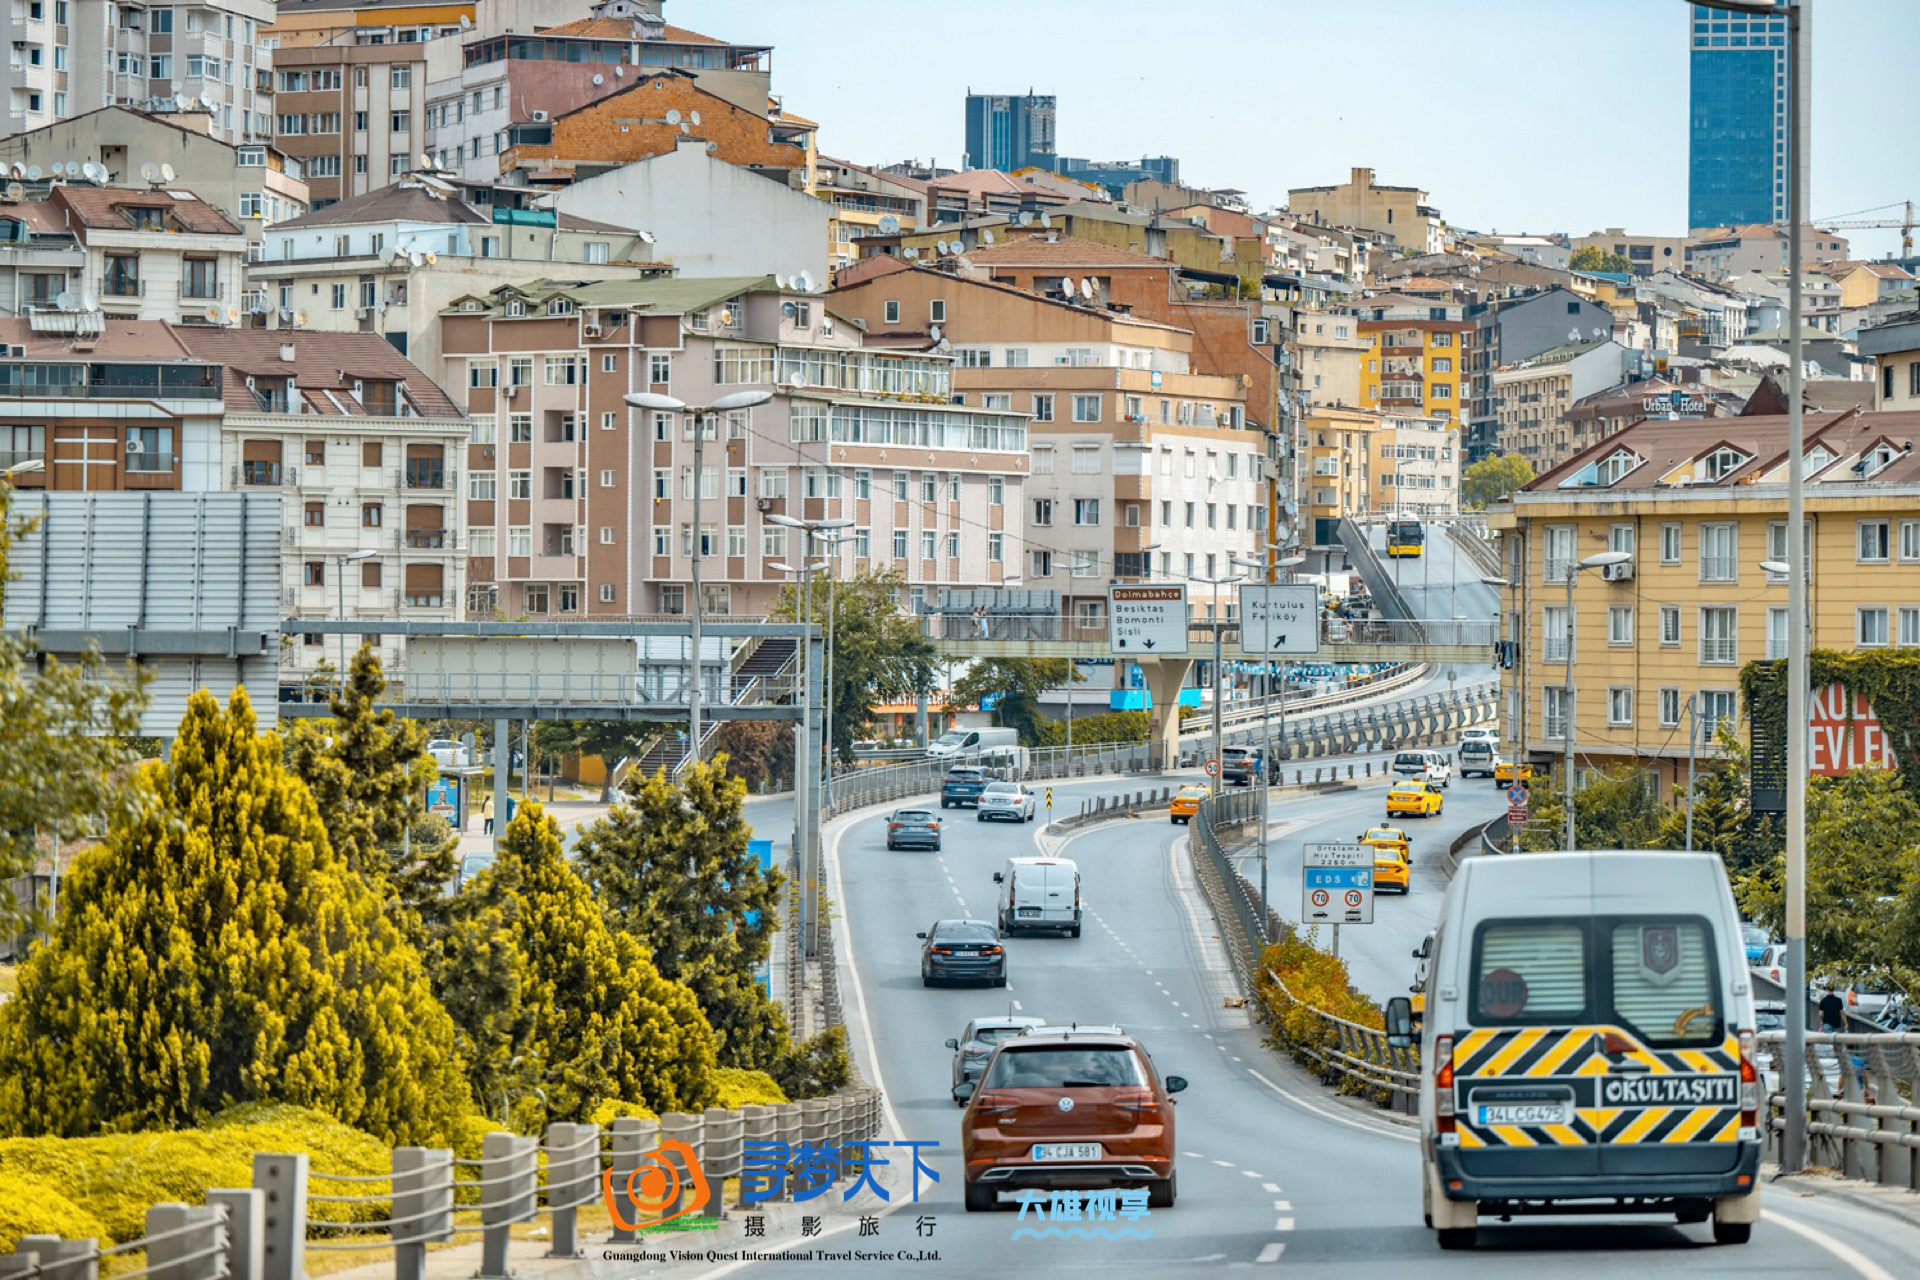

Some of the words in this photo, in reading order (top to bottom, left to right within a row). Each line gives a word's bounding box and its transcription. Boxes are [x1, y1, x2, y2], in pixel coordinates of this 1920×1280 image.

[1643, 397, 1672, 411] Urban
[1680, 397, 1707, 411] Hotel
[1114, 590, 1180, 599] Dolmabahçe
[1116, 616, 1164, 624] Bomonti
[1208, 763, 1218, 773] 50
[1315, 875, 1341, 884] EDS
[1315, 894, 1326, 902] 70
[1348, 894, 1359, 902] 70
[1482, 980, 1524, 1004] DUR
[1042, 1147, 1052, 1158] 34
[1056, 1147, 1074, 1157] CJA
[1078, 1146, 1096, 1157] 581
